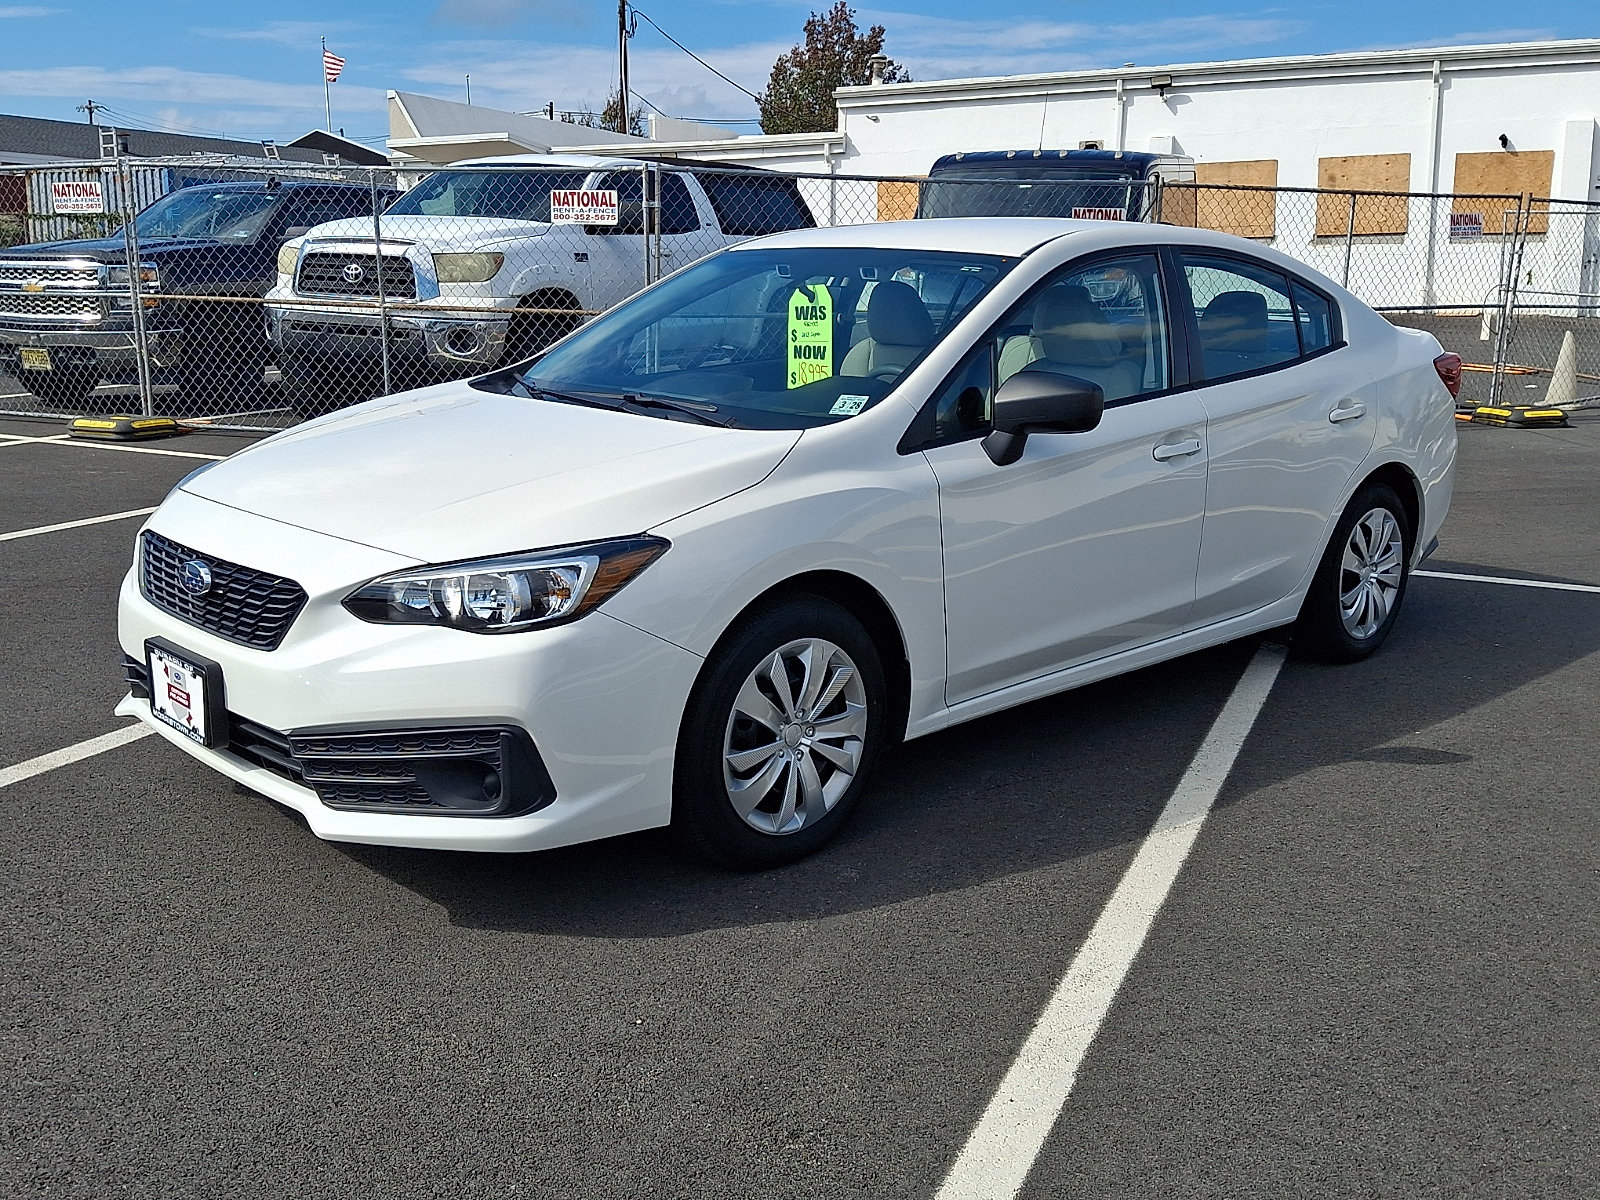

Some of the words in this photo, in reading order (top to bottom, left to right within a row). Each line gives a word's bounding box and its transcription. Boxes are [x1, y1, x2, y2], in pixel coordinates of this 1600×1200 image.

[53, 183, 100, 198] NATIONAL
[552, 191, 616, 207] NATIONAL
[553, 213, 617, 221] 800-352-5675
[1073, 208, 1124, 221] NATIONAL
[1450, 213, 1482, 227] NATIONAL
[794, 305, 827, 320] WAS
[791, 328, 798, 343] $
[793, 344, 827, 360] NOW
[790, 371, 797, 385] $
[798, 361, 829, 384] 18995
[839, 400, 847, 409] 3
